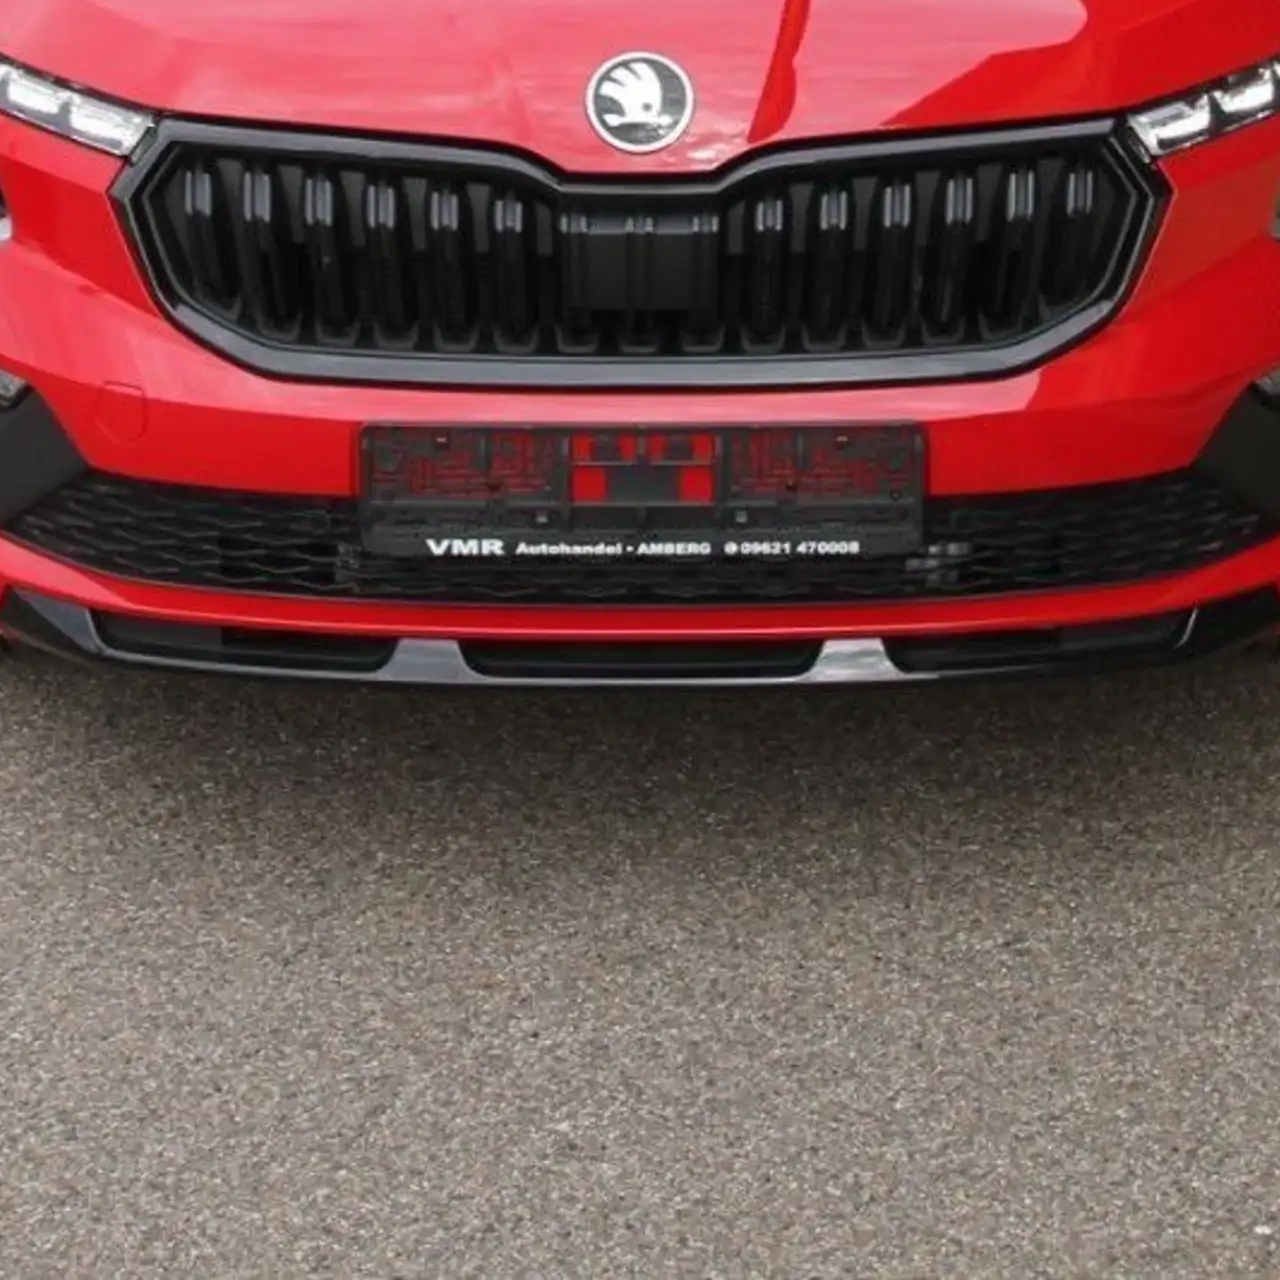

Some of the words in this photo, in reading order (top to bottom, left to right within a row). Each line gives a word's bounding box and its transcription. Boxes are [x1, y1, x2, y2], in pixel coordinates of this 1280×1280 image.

[425, 538, 504, 556] VMR
[515, 541, 621, 555] Autohandel
[637, 541, 711, 555] AMBERG
